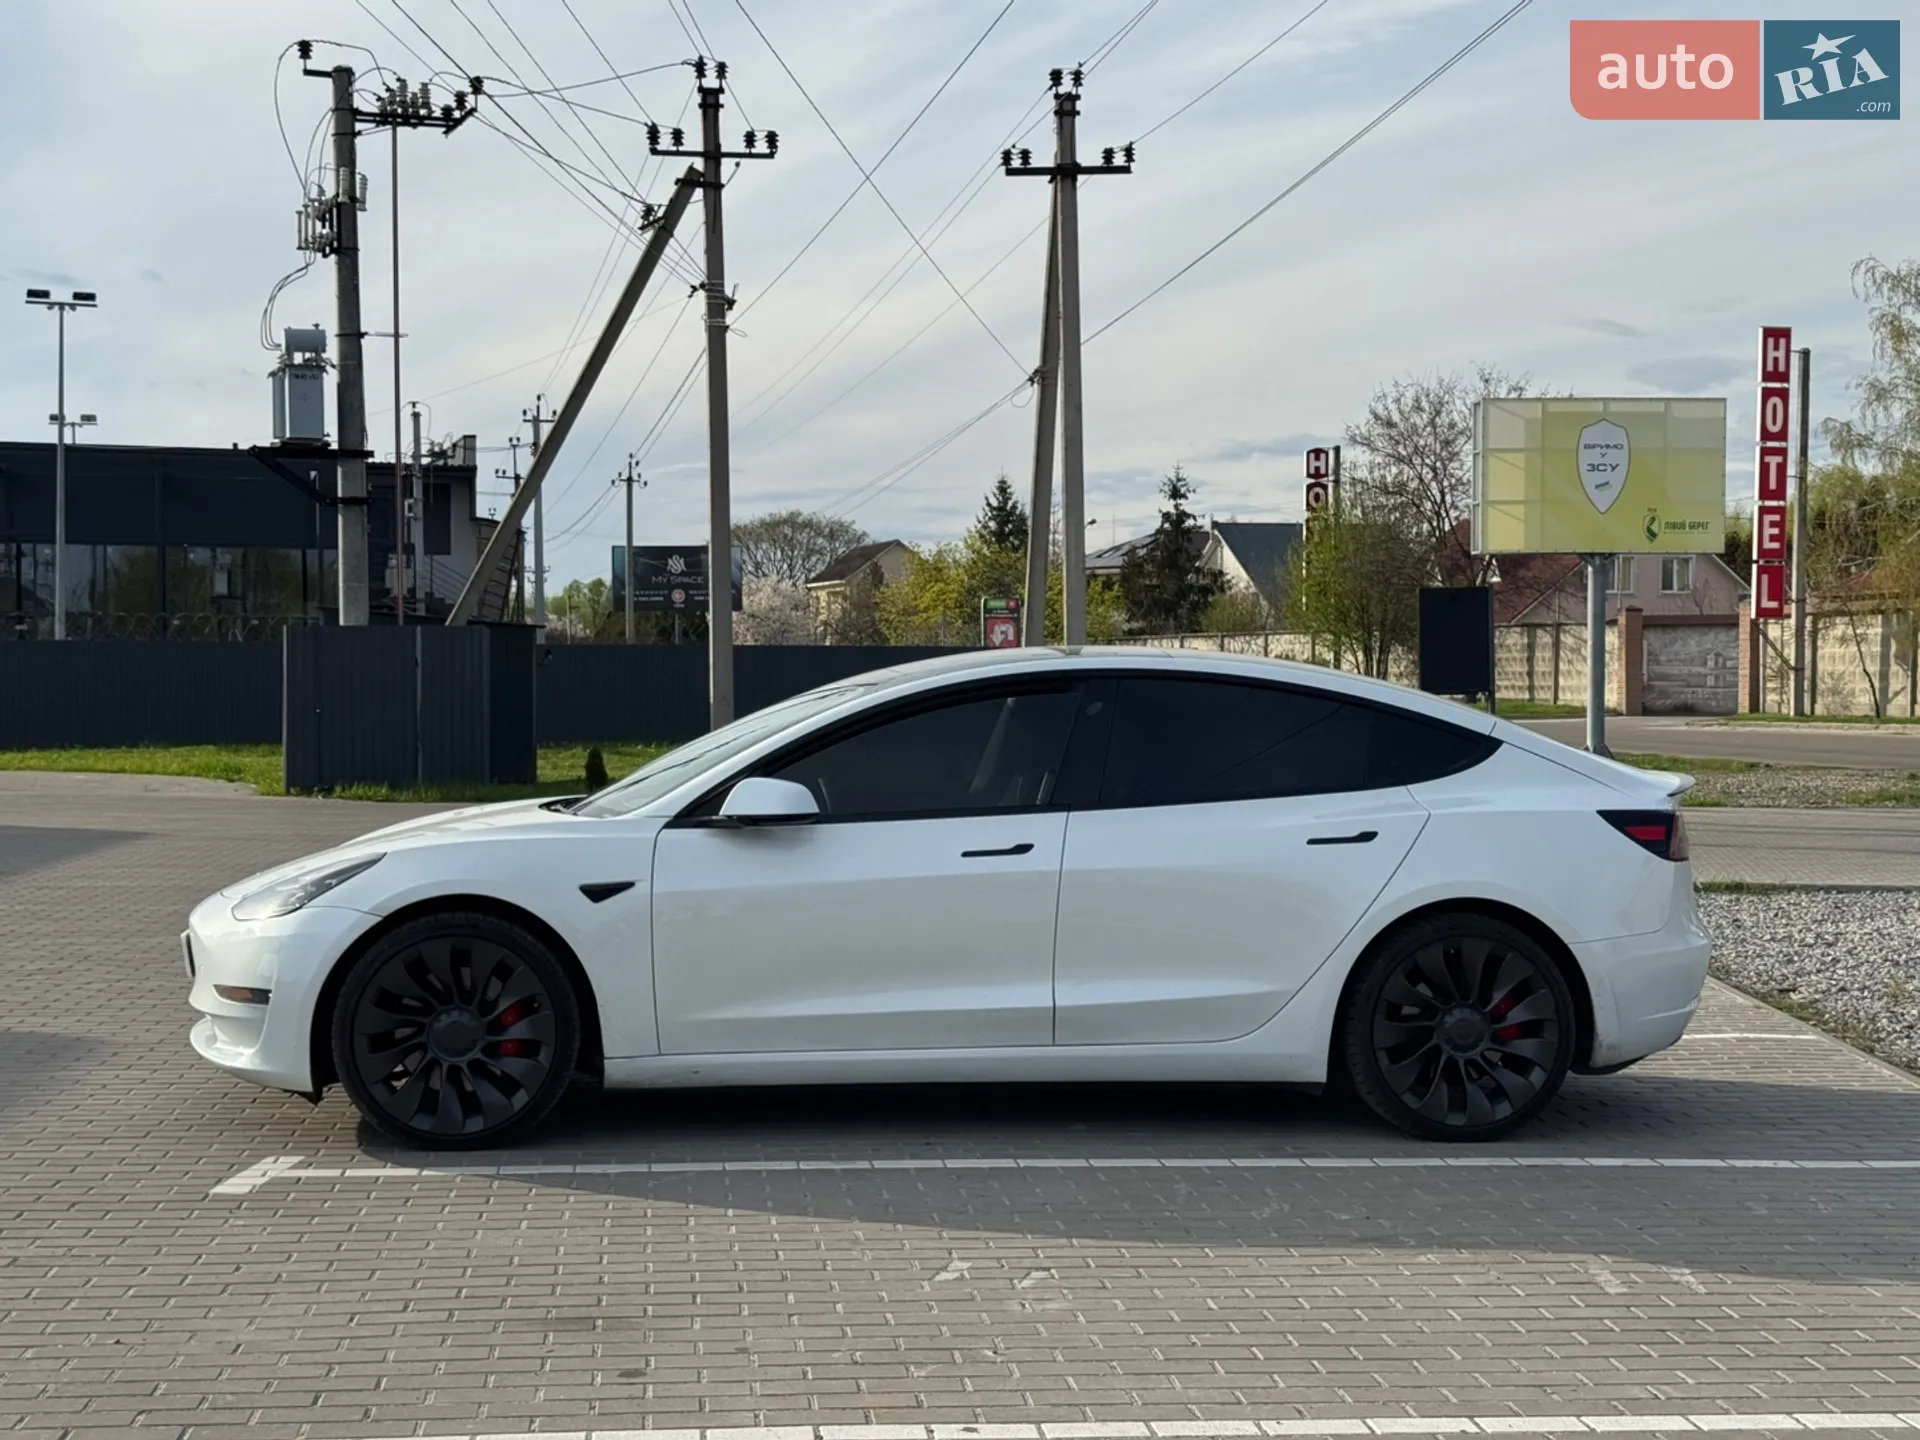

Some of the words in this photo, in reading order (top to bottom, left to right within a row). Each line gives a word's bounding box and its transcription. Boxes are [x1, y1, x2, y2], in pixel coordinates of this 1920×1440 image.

[1586, 463, 1620, 472] ЗСУ
[1760, 337, 1787, 609] HOTEL
[670, 575, 705, 584] SPACE
